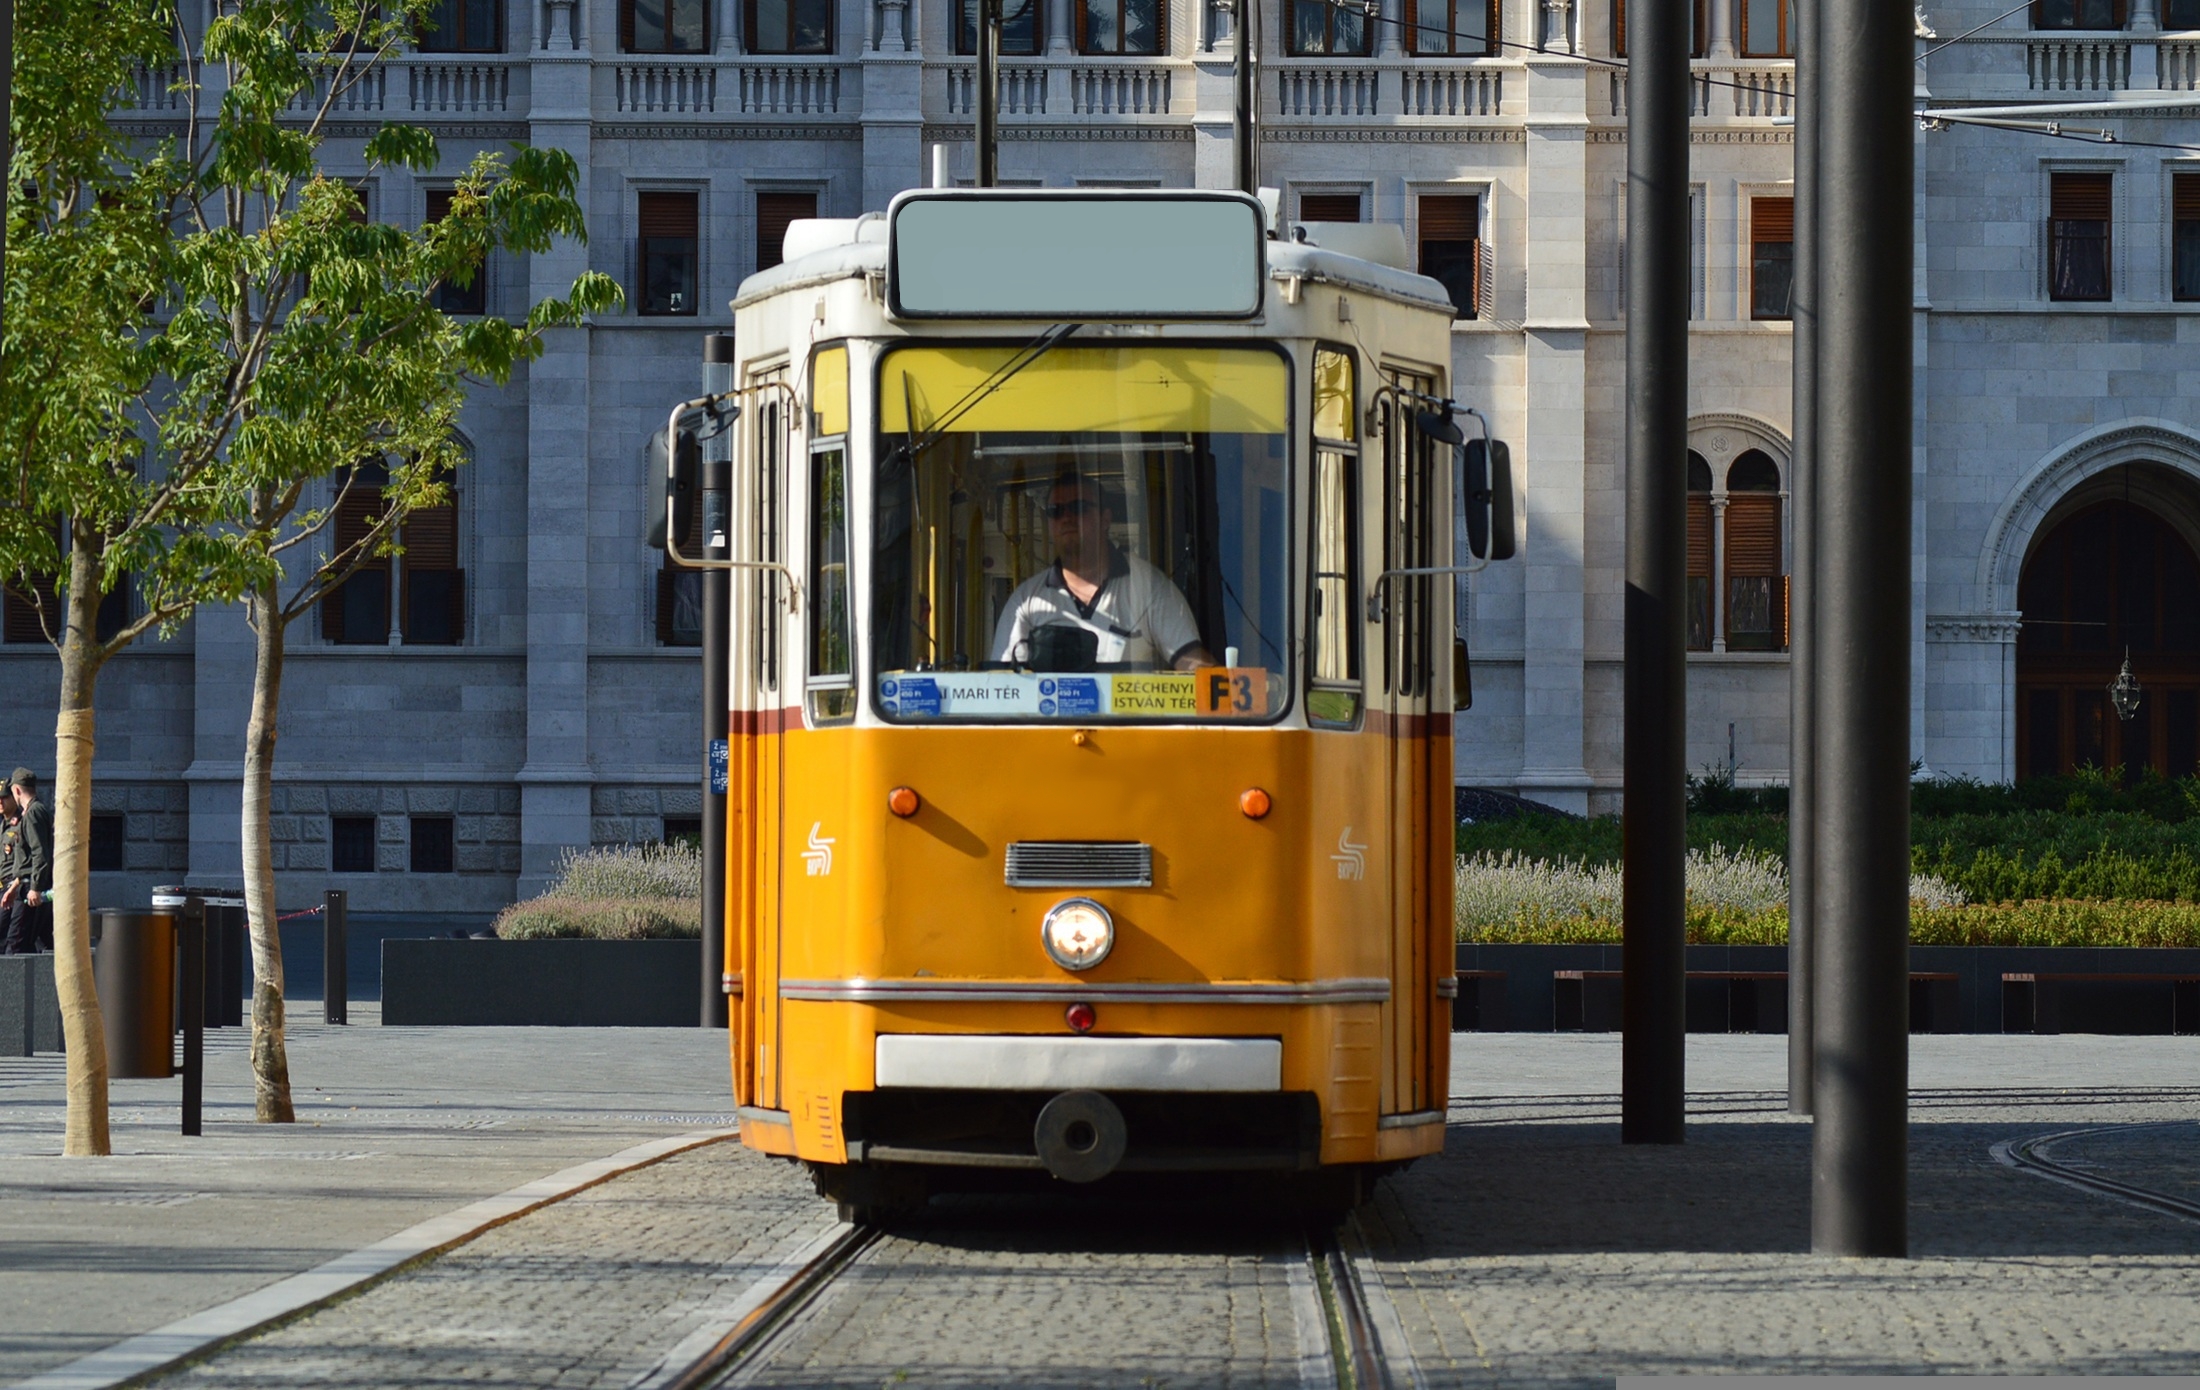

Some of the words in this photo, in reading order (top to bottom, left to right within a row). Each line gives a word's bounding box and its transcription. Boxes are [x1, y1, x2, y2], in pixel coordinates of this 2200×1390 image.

[952, 688, 989, 699] MARI
[994, 684, 1020, 699] TÉR
[1117, 679, 1194, 694] SZÉCHENYI
[1210, 675, 1253, 712] F3
[1114, 693, 1165, 709] ISTVÁN
[1171, 693, 1196, 709] TÉR
